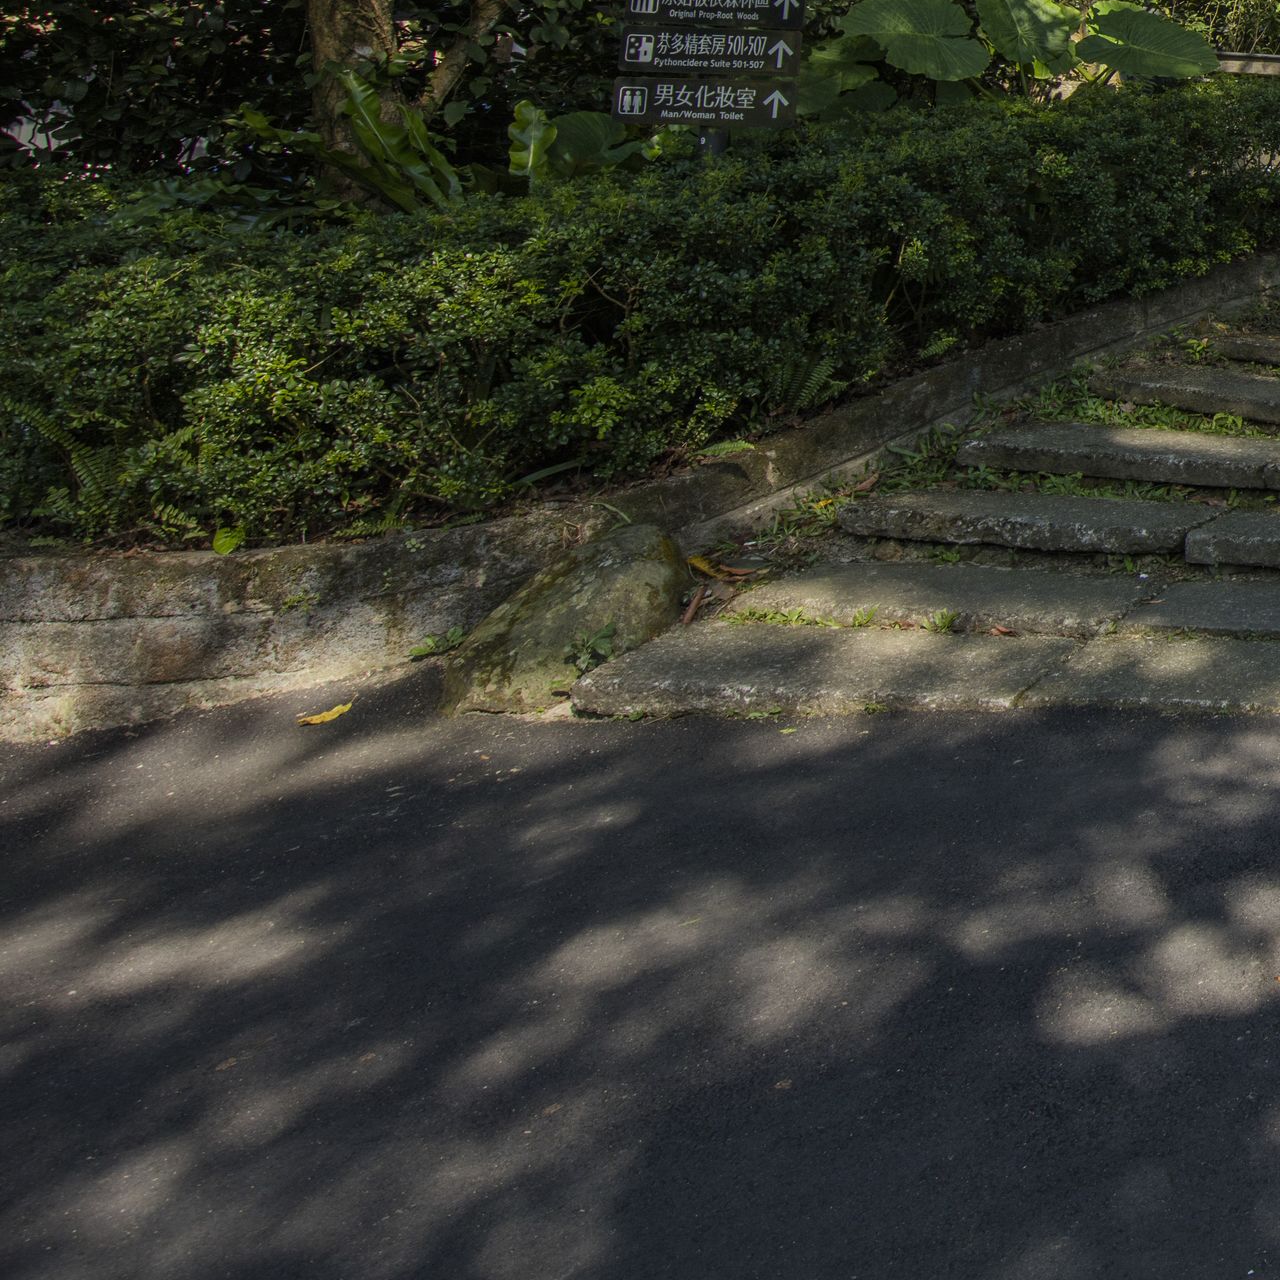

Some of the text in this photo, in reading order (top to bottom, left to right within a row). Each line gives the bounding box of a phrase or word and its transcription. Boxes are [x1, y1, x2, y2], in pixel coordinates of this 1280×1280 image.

[669, 8, 759, 21] Original Prop-Root Woods
[710, 59, 730, 68] Suite
[732, 60, 765, 69] 501-507
[654, 84, 756, 109] 男女化妝室
[661, 109, 744, 121] Man/Woman Toilet
[700, 136, 706, 145] 9
